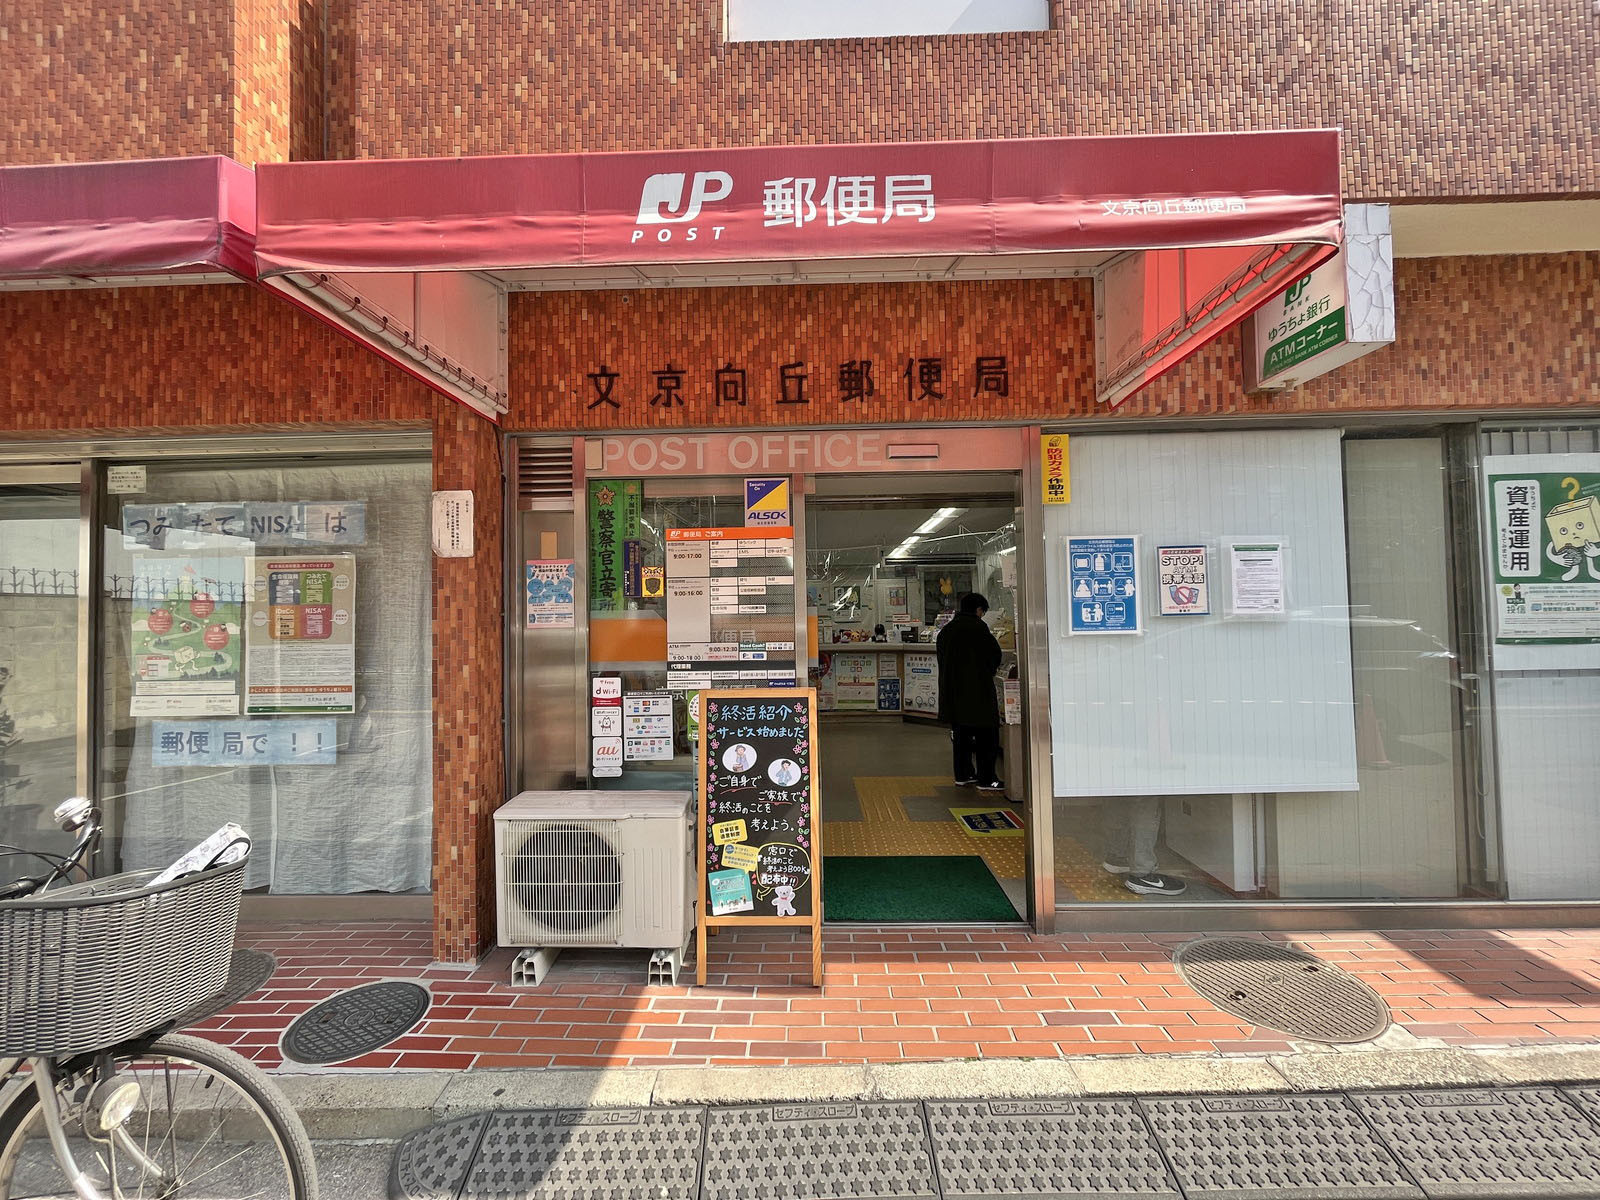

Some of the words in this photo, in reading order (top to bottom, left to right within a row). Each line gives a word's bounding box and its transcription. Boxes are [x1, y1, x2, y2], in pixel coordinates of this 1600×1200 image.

[763, 174, 936, 228] 郵便局
[1101, 197, 1246, 217] 文京向丘郵便局
[631, 226, 725, 243] POST
[1268, 294, 1331, 342] ゆうちょ銀行
[1270, 321, 1338, 365] ATMコーナー
[586, 355, 1010, 410] 文京向丘郵便局
[602, 436, 710, 472] POST
[727, 433, 882, 470] OFFICE
[748, 511, 787, 520] ALSOK
[1506, 485, 1530, 571] 資産運用
[597, 509, 617, 611] 警察官立寄所
[1161, 554, 1204, 566] STOP!
[720, 704, 793, 721] 終活紹介
[716, 725, 805, 740] サービス始めました
[597, 746, 620, 756] au
[719, 774, 762, 788] ご自身で
[758, 789, 801, 802] ご家族で
[718, 801, 772, 815] 終活のことを
[767, 845, 798, 857] 窓口で
[775, 1103, 856, 1119] セフティ・スロープ
